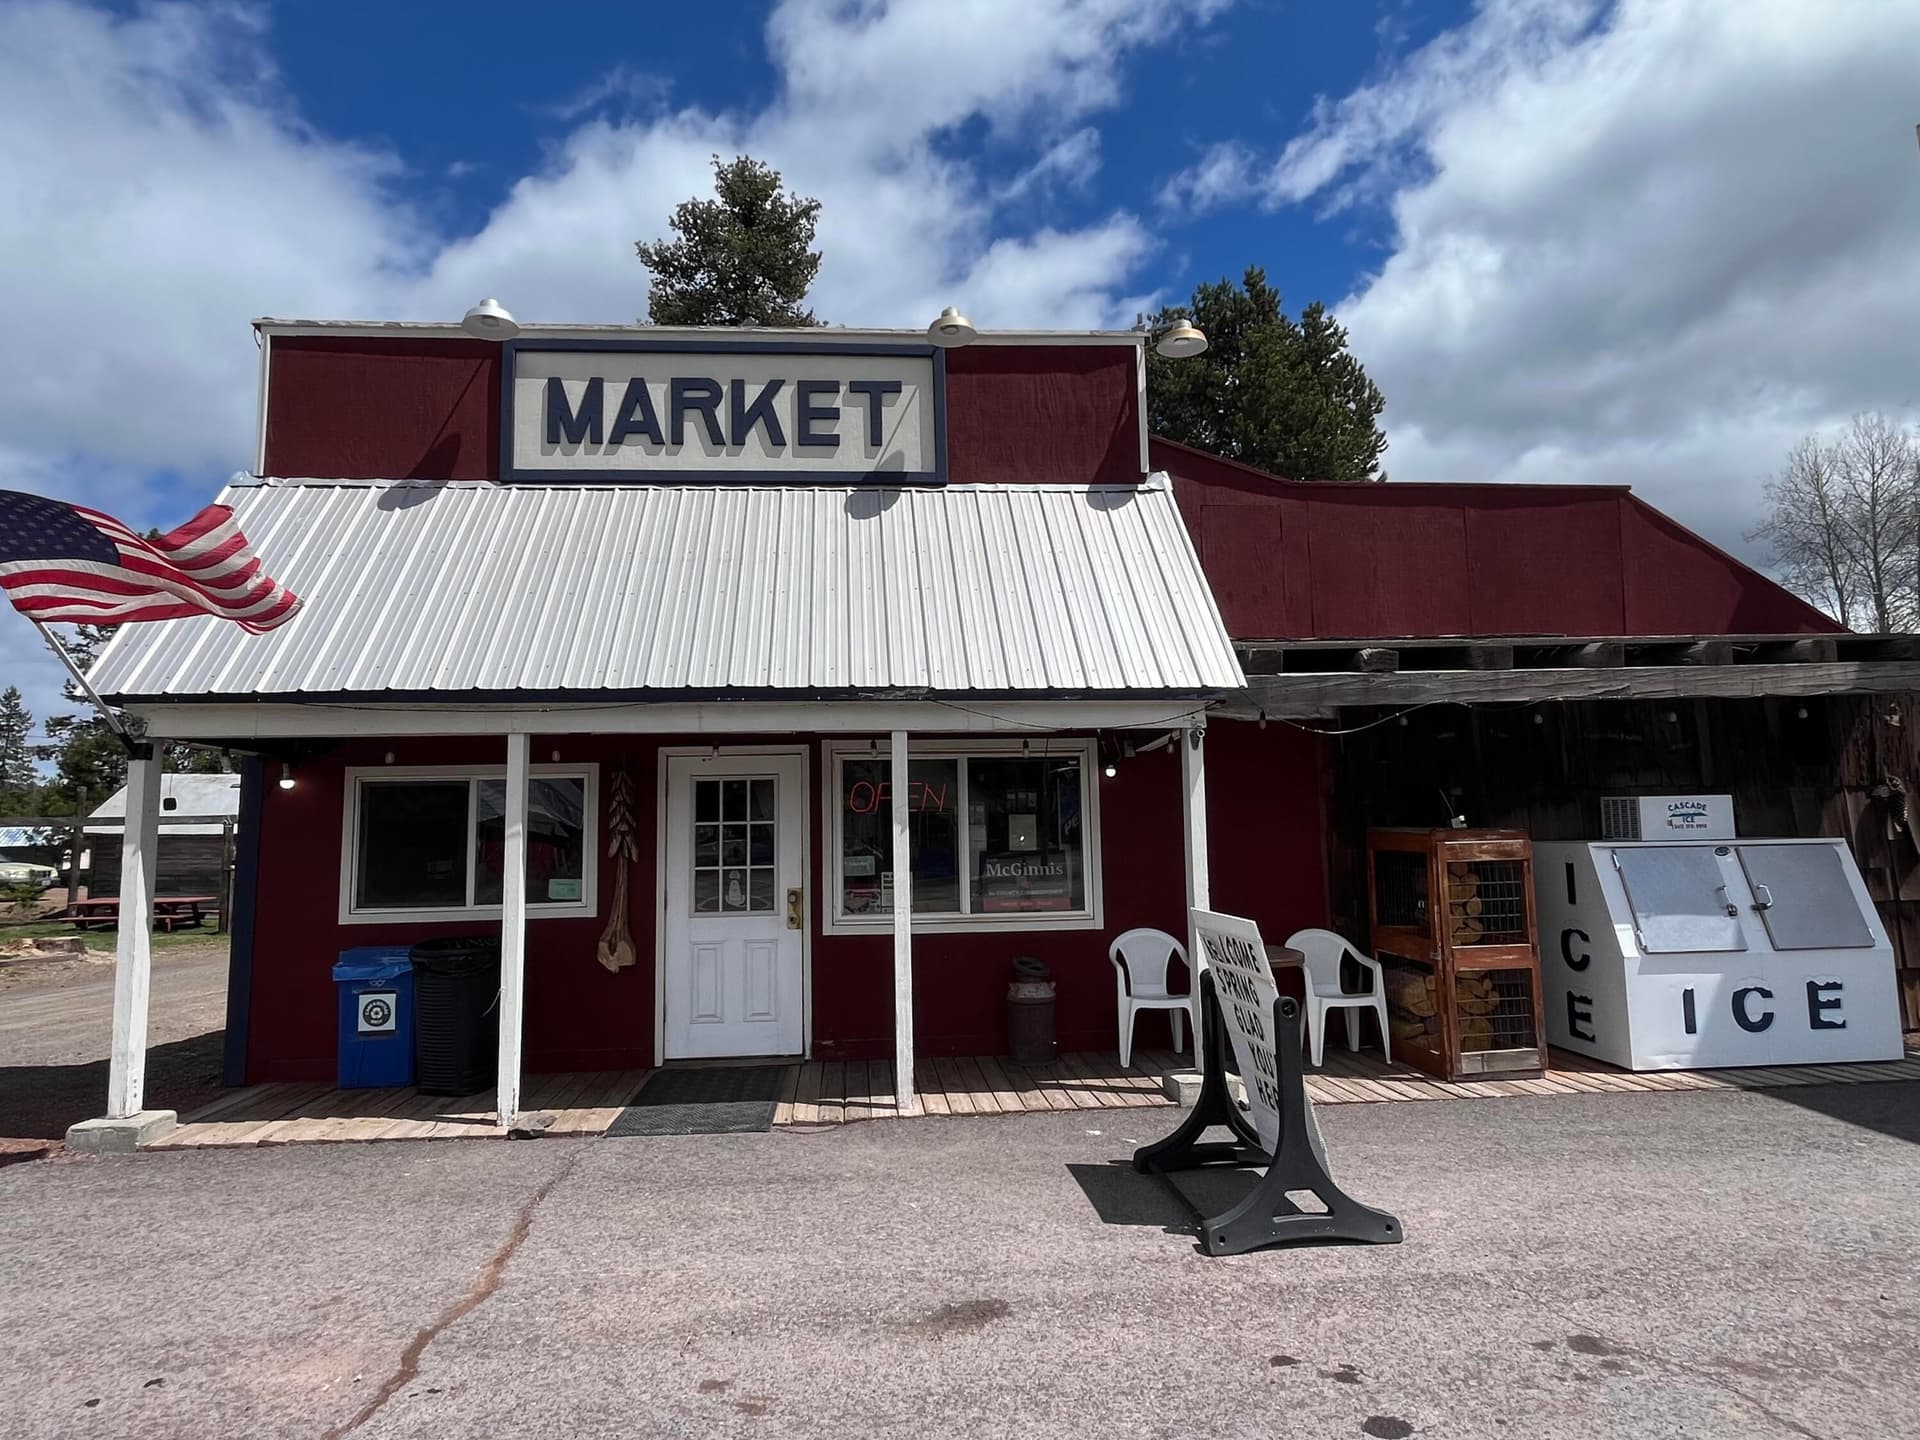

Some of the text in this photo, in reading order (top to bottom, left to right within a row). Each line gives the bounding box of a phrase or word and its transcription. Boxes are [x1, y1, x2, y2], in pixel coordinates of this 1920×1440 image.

[546, 376, 903, 447] MARKET
[1667, 801, 1707, 811] CASCADE
[1682, 815, 1695, 823] ICE
[986, 862, 1063, 877] McGinnis
[1560, 862, 1596, 1042] ICE
[1216, 966, 1260, 1007] SPRING
[1234, 1003, 1265, 1042] GLAD
[1682, 980, 1847, 1035] ICE
[1255, 1075, 1280, 1111] HER
